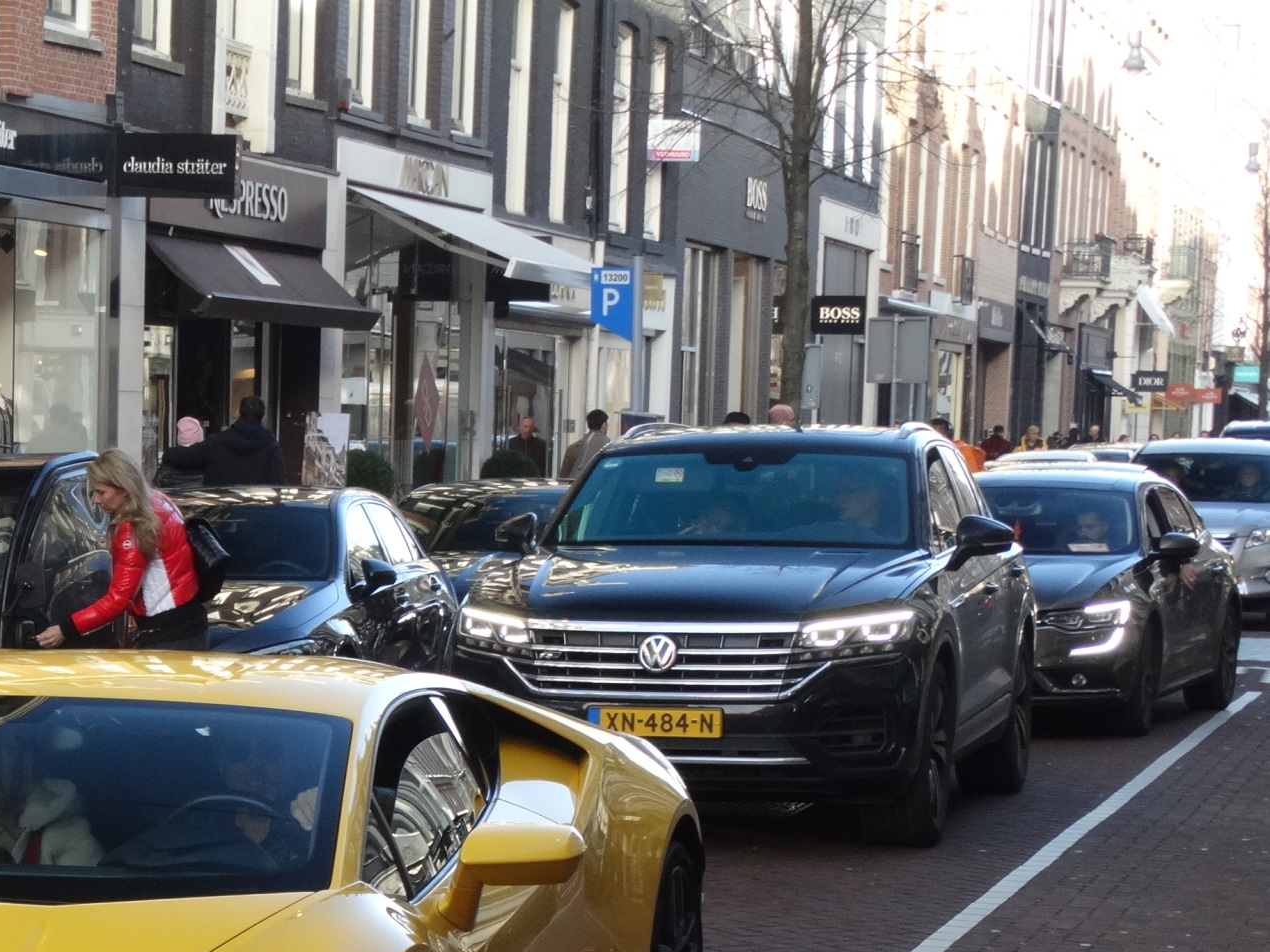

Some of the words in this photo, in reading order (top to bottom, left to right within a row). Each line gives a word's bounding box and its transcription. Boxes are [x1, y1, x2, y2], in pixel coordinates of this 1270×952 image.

[123, 156, 174, 174] claudia
[176, 158, 227, 175] sträter
[746, 177, 767, 212] BOSS
[603, 273, 628, 282] 13200
[603, 288, 620, 316] P
[819, 306, 861, 320] BOSS
[1138, 377, 1164, 386] DIOR
[606, 712, 714, 734] XN-484-N
